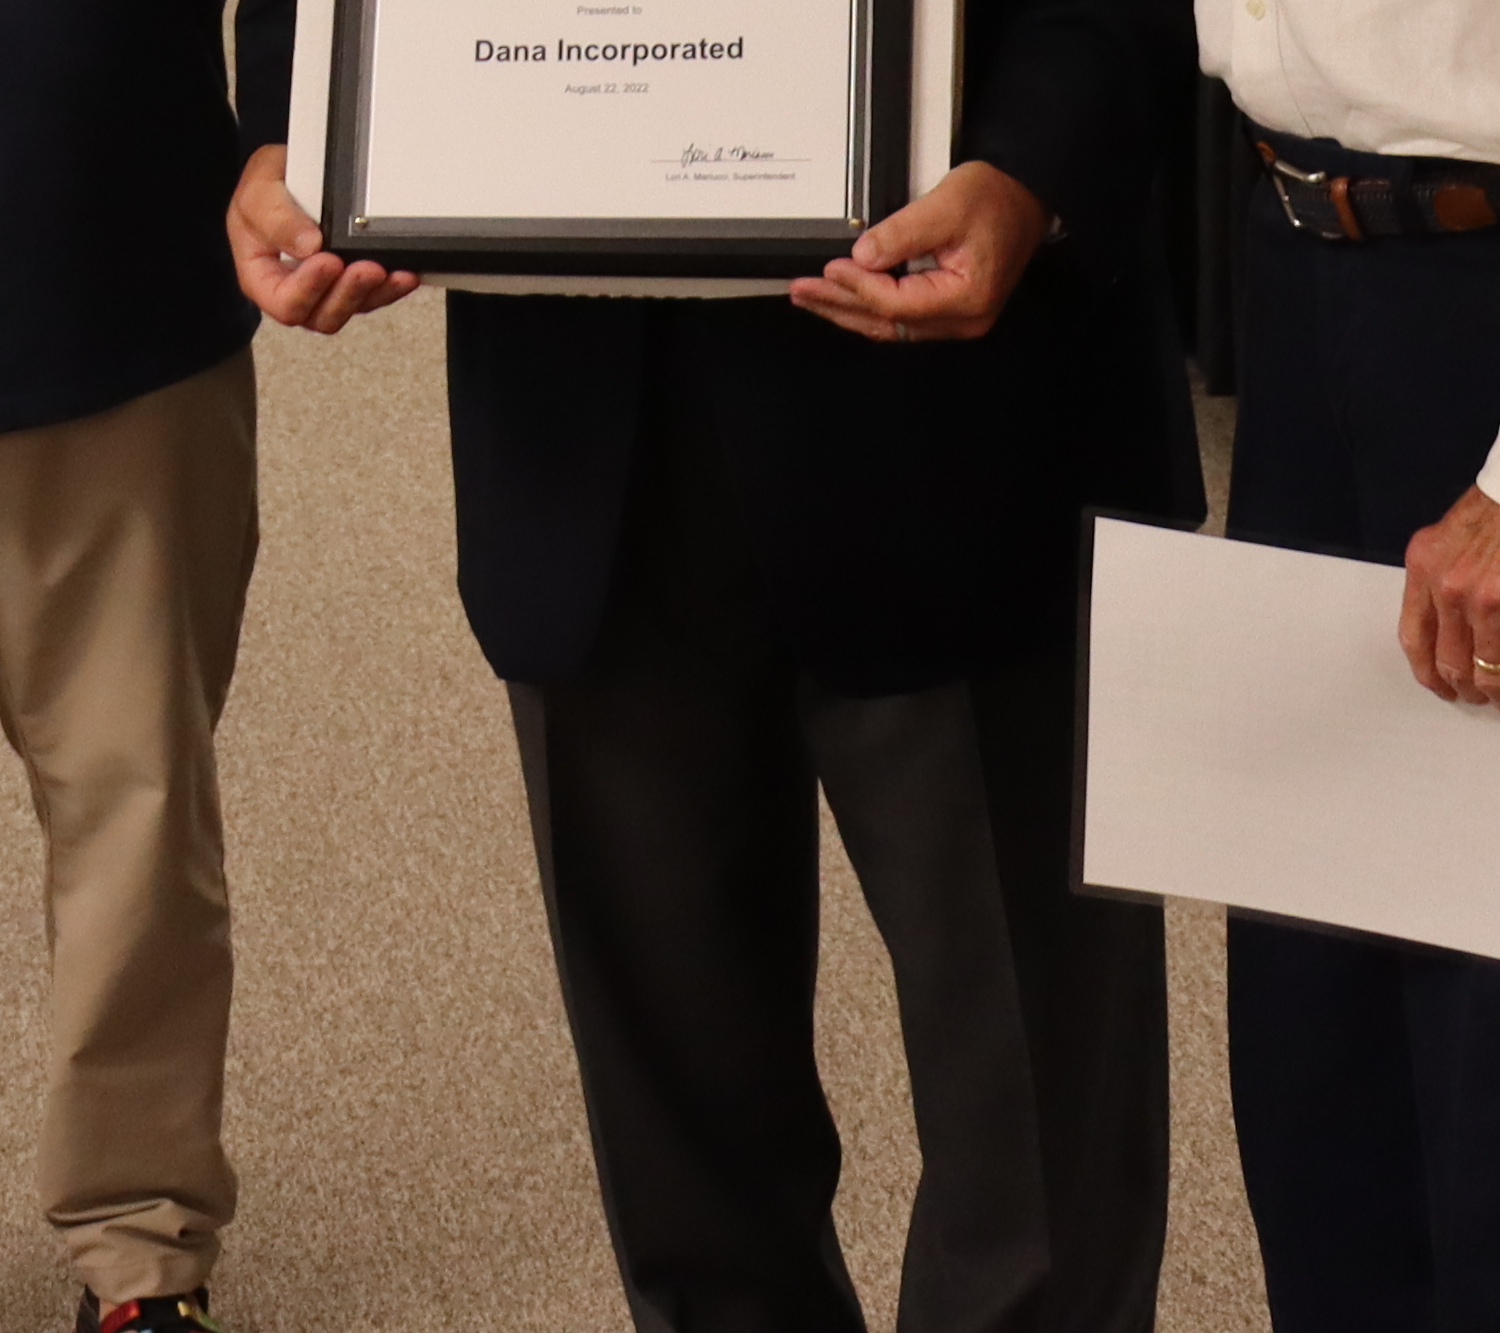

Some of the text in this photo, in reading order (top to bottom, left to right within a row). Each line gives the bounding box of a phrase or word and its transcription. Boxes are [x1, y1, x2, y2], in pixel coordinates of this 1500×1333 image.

[577, 5, 643, 16] Presented to
[474, 36, 745, 66] Dana Incorporated
[564, 82, 602, 96] August
[623, 82, 649, 93] 2022
